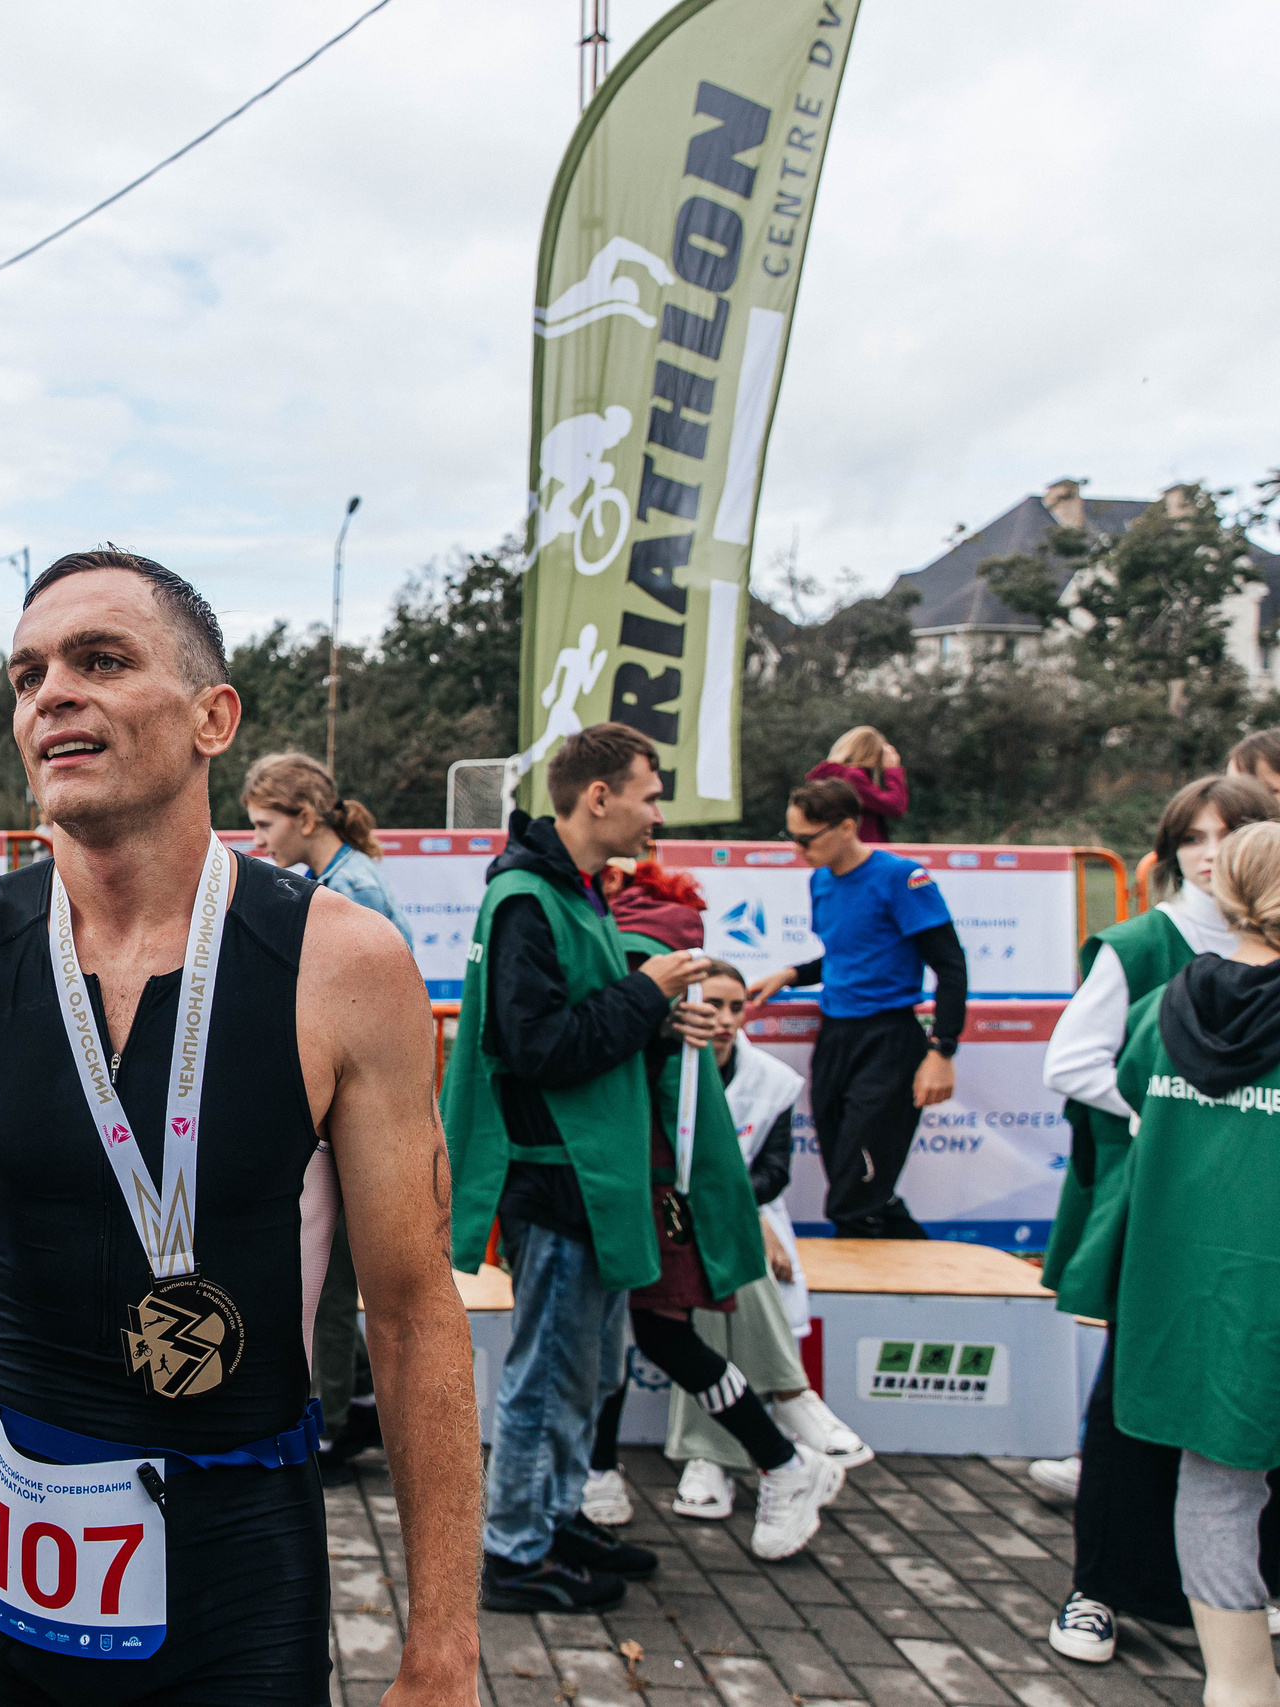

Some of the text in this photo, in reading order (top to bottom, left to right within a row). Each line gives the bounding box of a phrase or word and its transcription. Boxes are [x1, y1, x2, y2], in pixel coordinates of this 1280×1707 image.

[763, 92, 824, 279] CENTRE
[69, 991, 116, 1105] О.РУССКИЙ
[177, 972, 208, 1099] ЧЕМПИОНАТ
[159, 1280, 197, 1294] ЧЕМПИОНАТ
[198, 1281, 238, 1313] ПРИМОРСКОГО
[202, 1290, 237, 1331] ВЛАДИВОСТОК
[238, 1327, 246, 1339] ПО
[228, 1338, 245, 1375] ТРИАТЛОНУ
[872, 1375, 988, 1392] TRIATHLON
[45, 1480, 133, 1495] СОРЕВНОВАНИЯ
[121, 1636, 143, 1648] Helios
